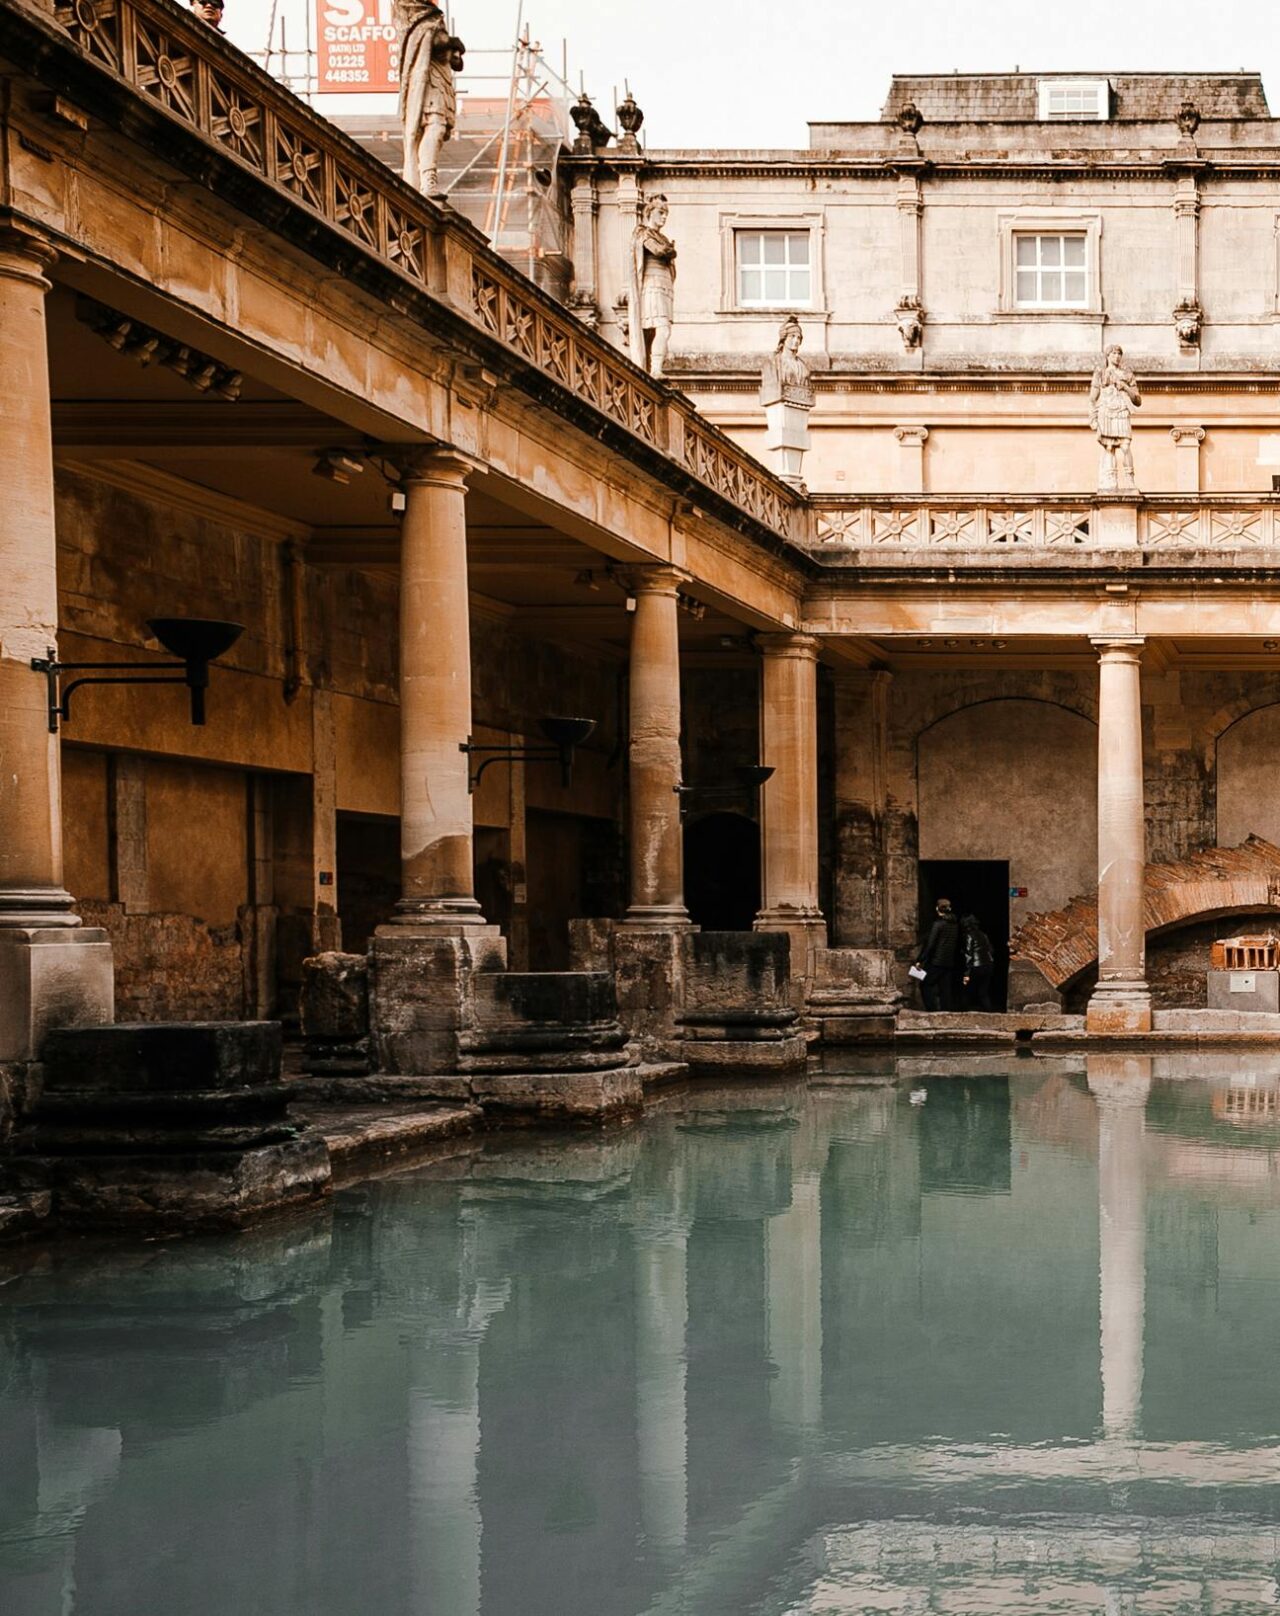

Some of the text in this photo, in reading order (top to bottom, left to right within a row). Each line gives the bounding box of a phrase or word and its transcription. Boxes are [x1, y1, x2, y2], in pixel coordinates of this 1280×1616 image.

[324, 26, 396, 41] SCAFFO
[328, 55, 365, 68] 01225
[325, 70, 369, 82] 448352
